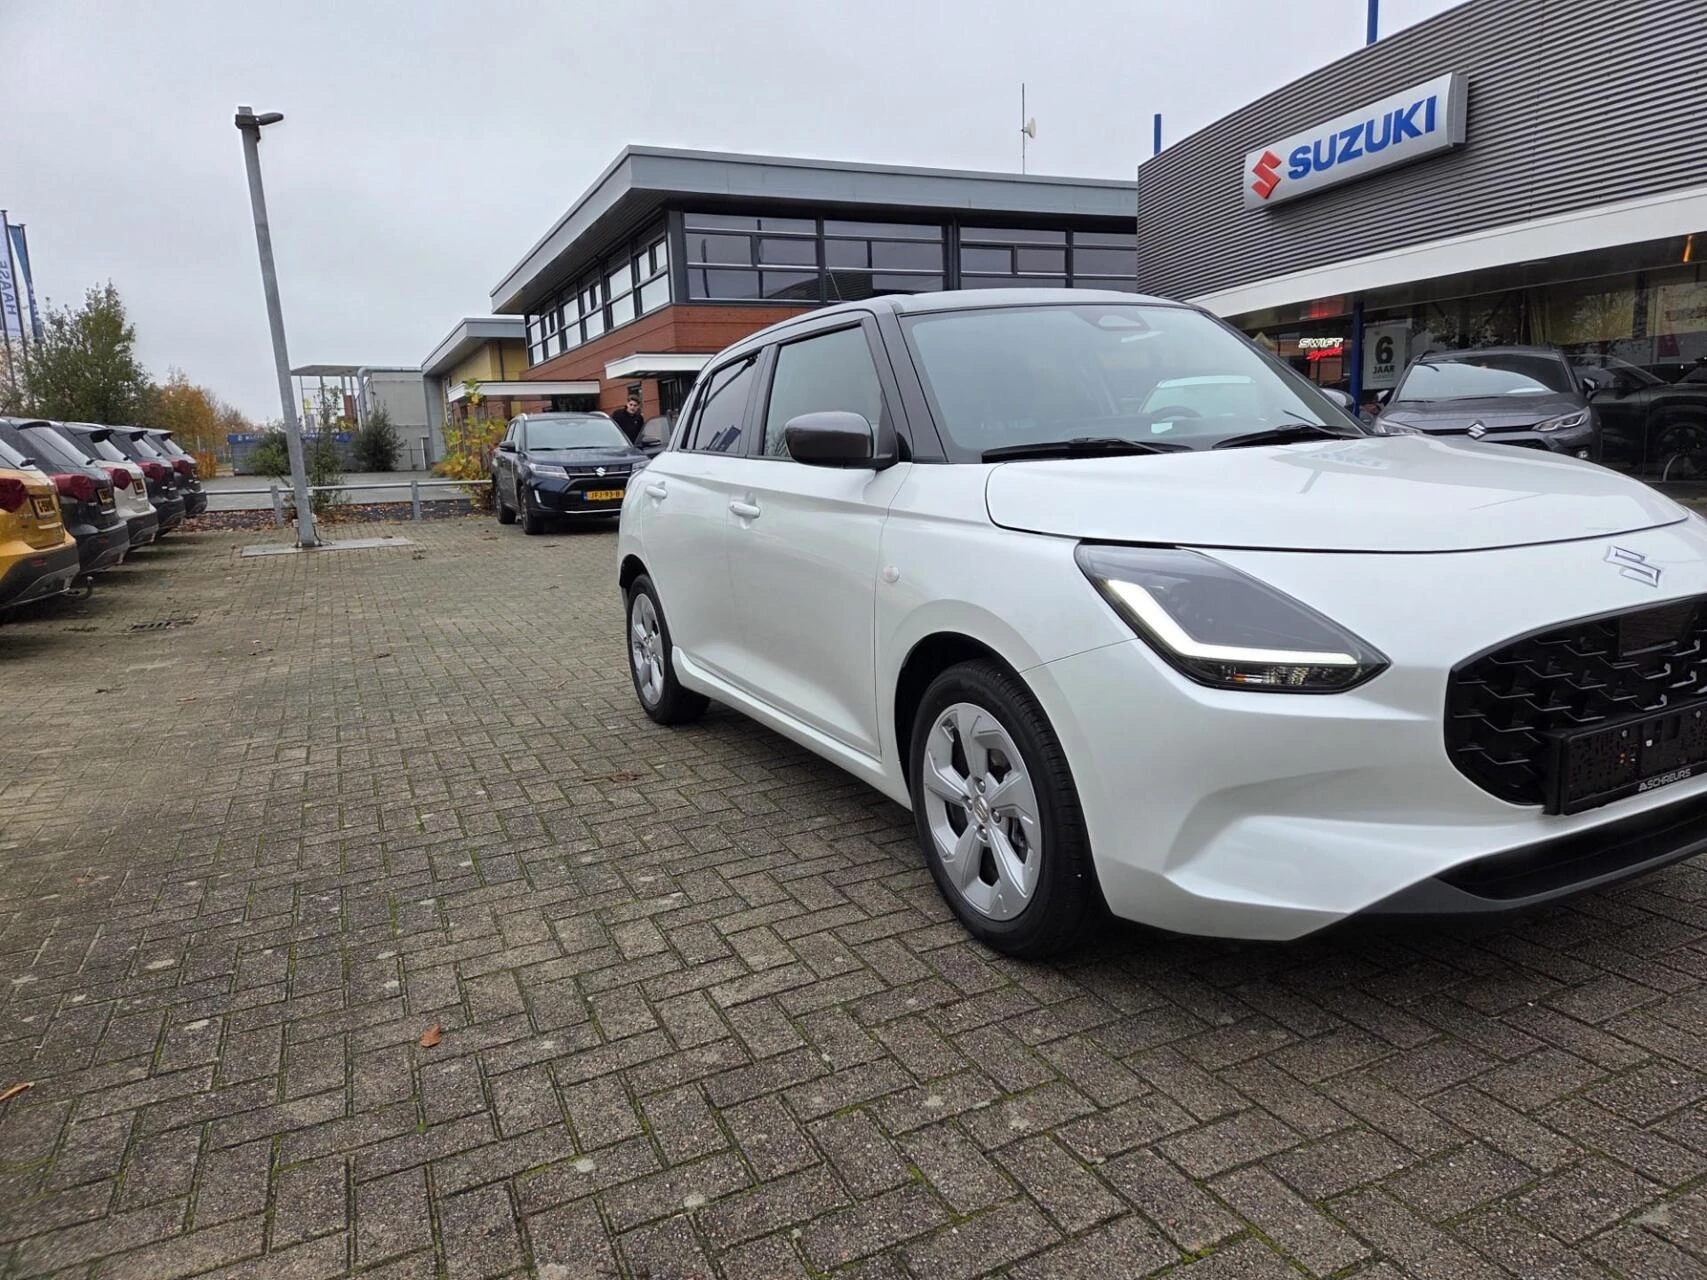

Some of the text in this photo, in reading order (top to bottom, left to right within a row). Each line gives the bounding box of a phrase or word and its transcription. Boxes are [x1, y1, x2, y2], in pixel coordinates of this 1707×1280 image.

[1288, 95, 1437, 180] SUZUKI
[1298, 337, 1344, 348] SWIFT
[1375, 336, 1394, 365] 6
[1373, 364, 1396, 375] JAAR
